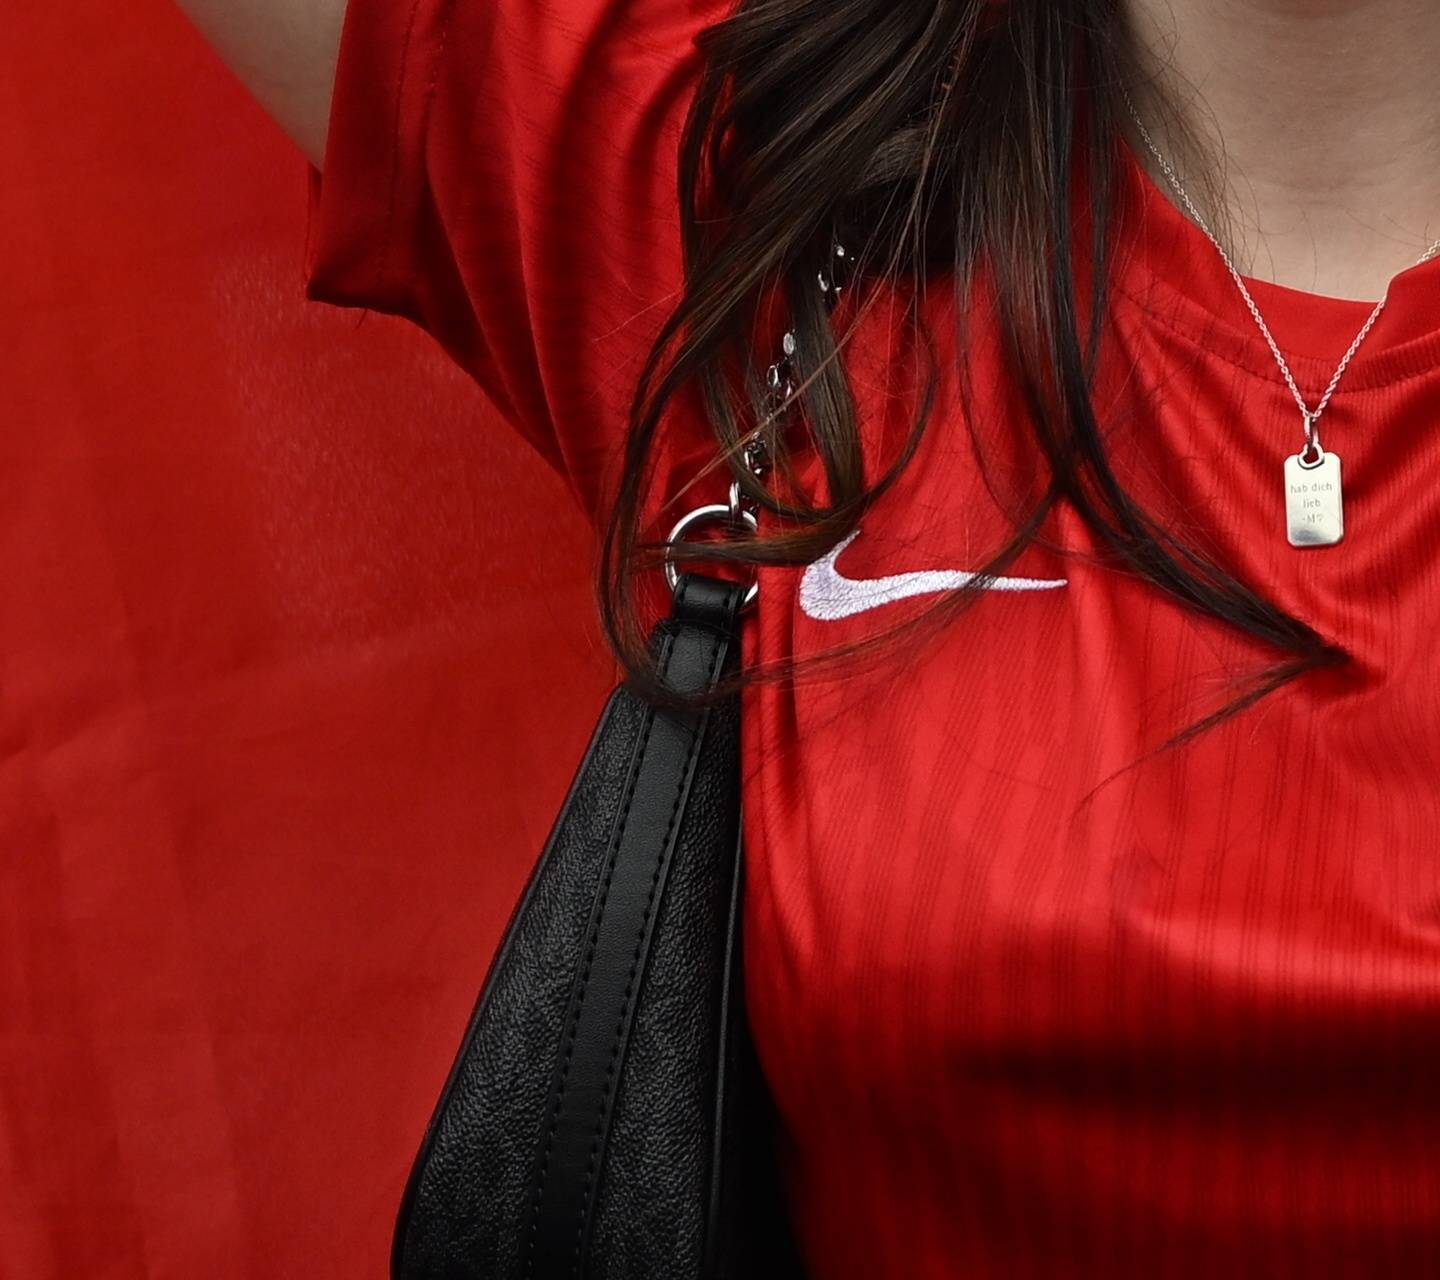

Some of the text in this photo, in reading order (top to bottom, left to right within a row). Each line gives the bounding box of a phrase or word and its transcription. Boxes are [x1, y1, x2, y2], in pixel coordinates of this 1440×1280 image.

[1290, 482, 1332, 493] hab dich
[1303, 499, 1321, 508] lieb
